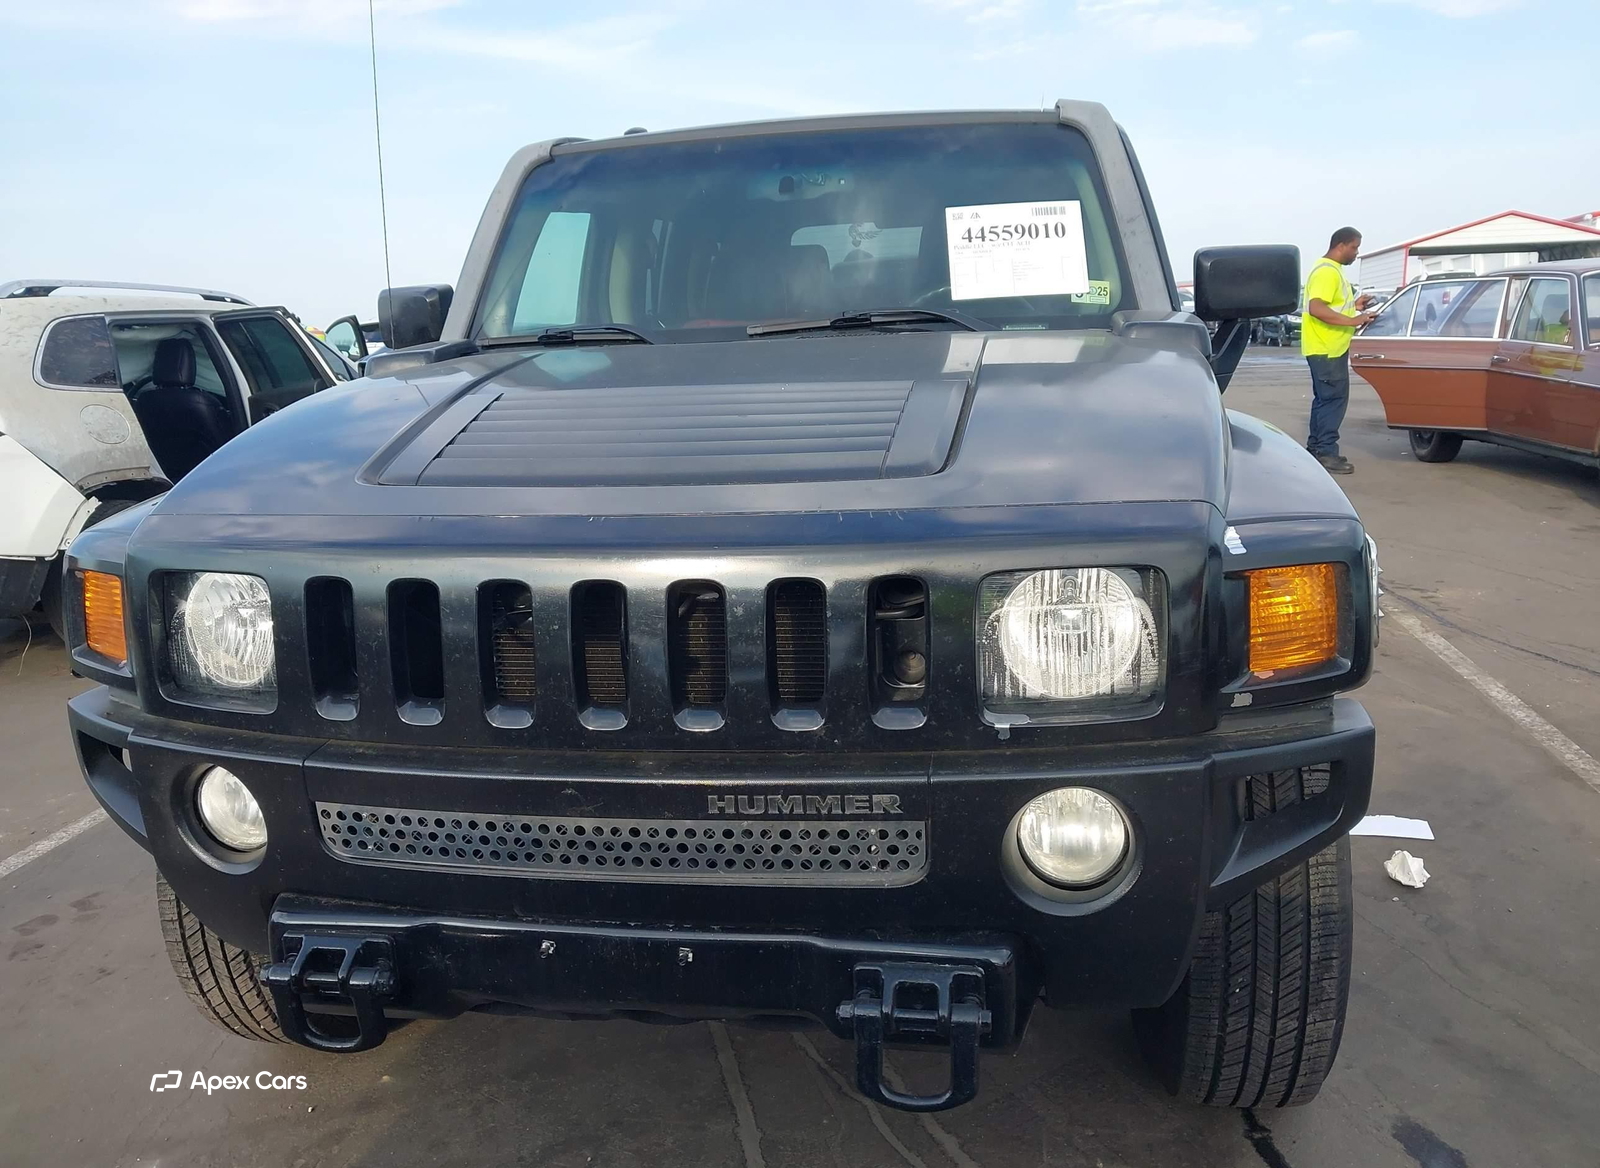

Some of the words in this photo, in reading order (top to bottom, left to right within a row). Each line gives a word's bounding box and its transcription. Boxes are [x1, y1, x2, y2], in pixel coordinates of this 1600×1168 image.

[961, 221, 1066, 243] 44559010
[1097, 286, 1109, 297] 25
[707, 794, 904, 815] HUMMER
